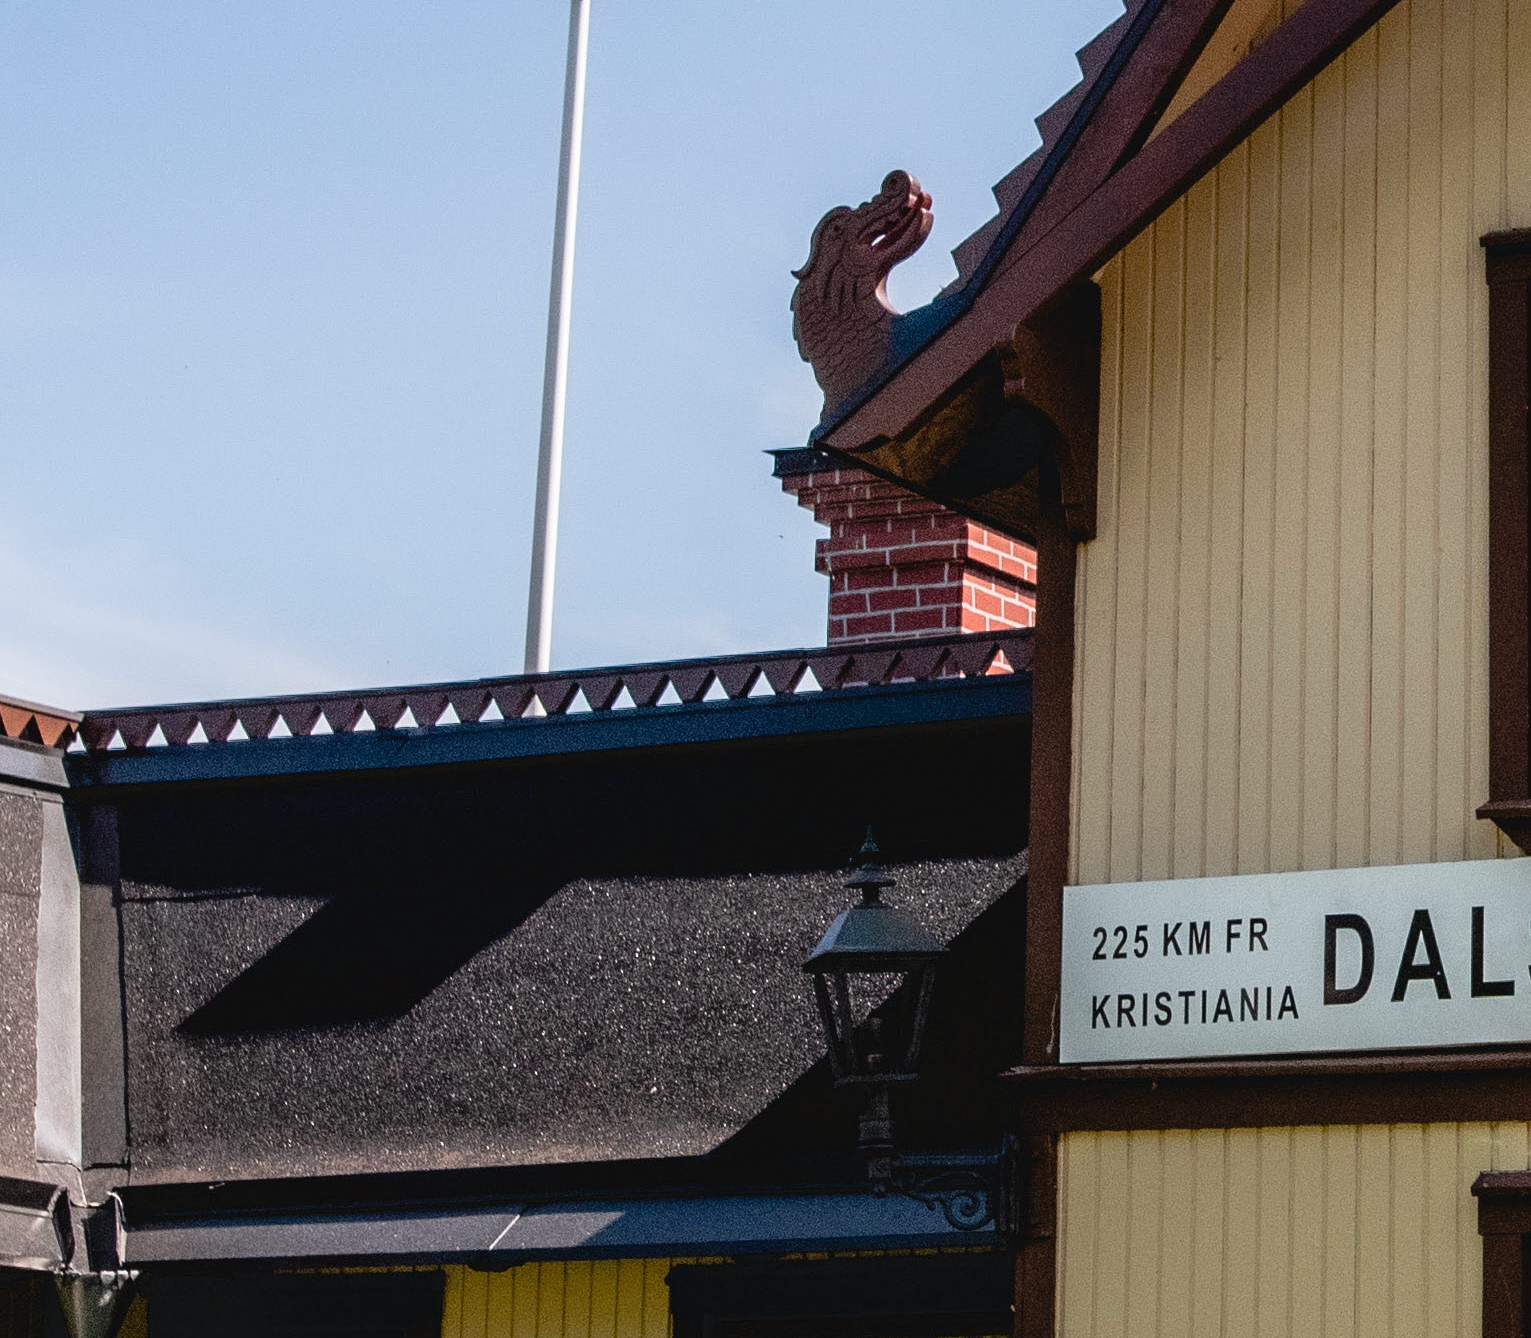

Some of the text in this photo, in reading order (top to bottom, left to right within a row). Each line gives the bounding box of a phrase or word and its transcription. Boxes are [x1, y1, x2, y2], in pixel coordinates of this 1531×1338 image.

[1092, 917, 1268, 961] 225 KM FR
[1091, 985, 1299, 1029] KRISTIANIA
